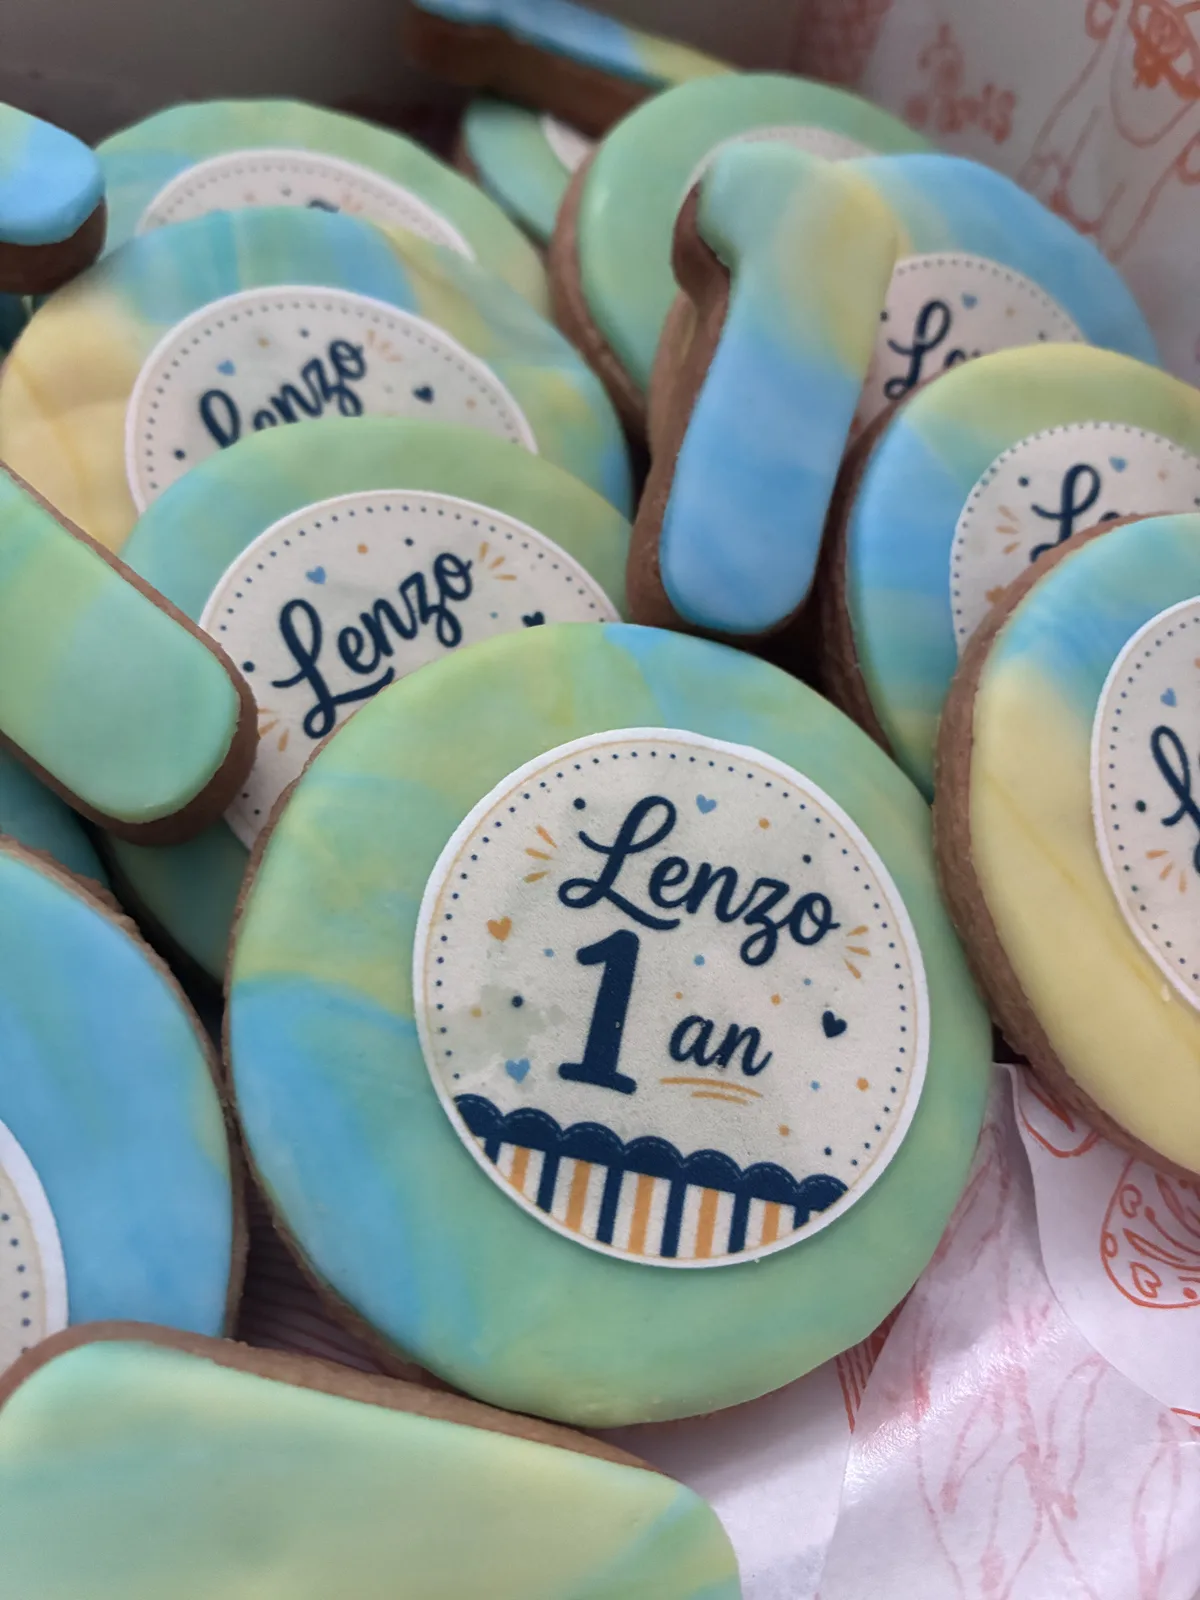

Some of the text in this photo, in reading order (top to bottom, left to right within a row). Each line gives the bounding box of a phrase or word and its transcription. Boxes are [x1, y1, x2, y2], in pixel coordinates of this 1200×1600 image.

[271, 552, 473, 739] Lenzo
[557, 795, 841, 966] Lenzo
[557, 929, 773, 1095] 1 an
